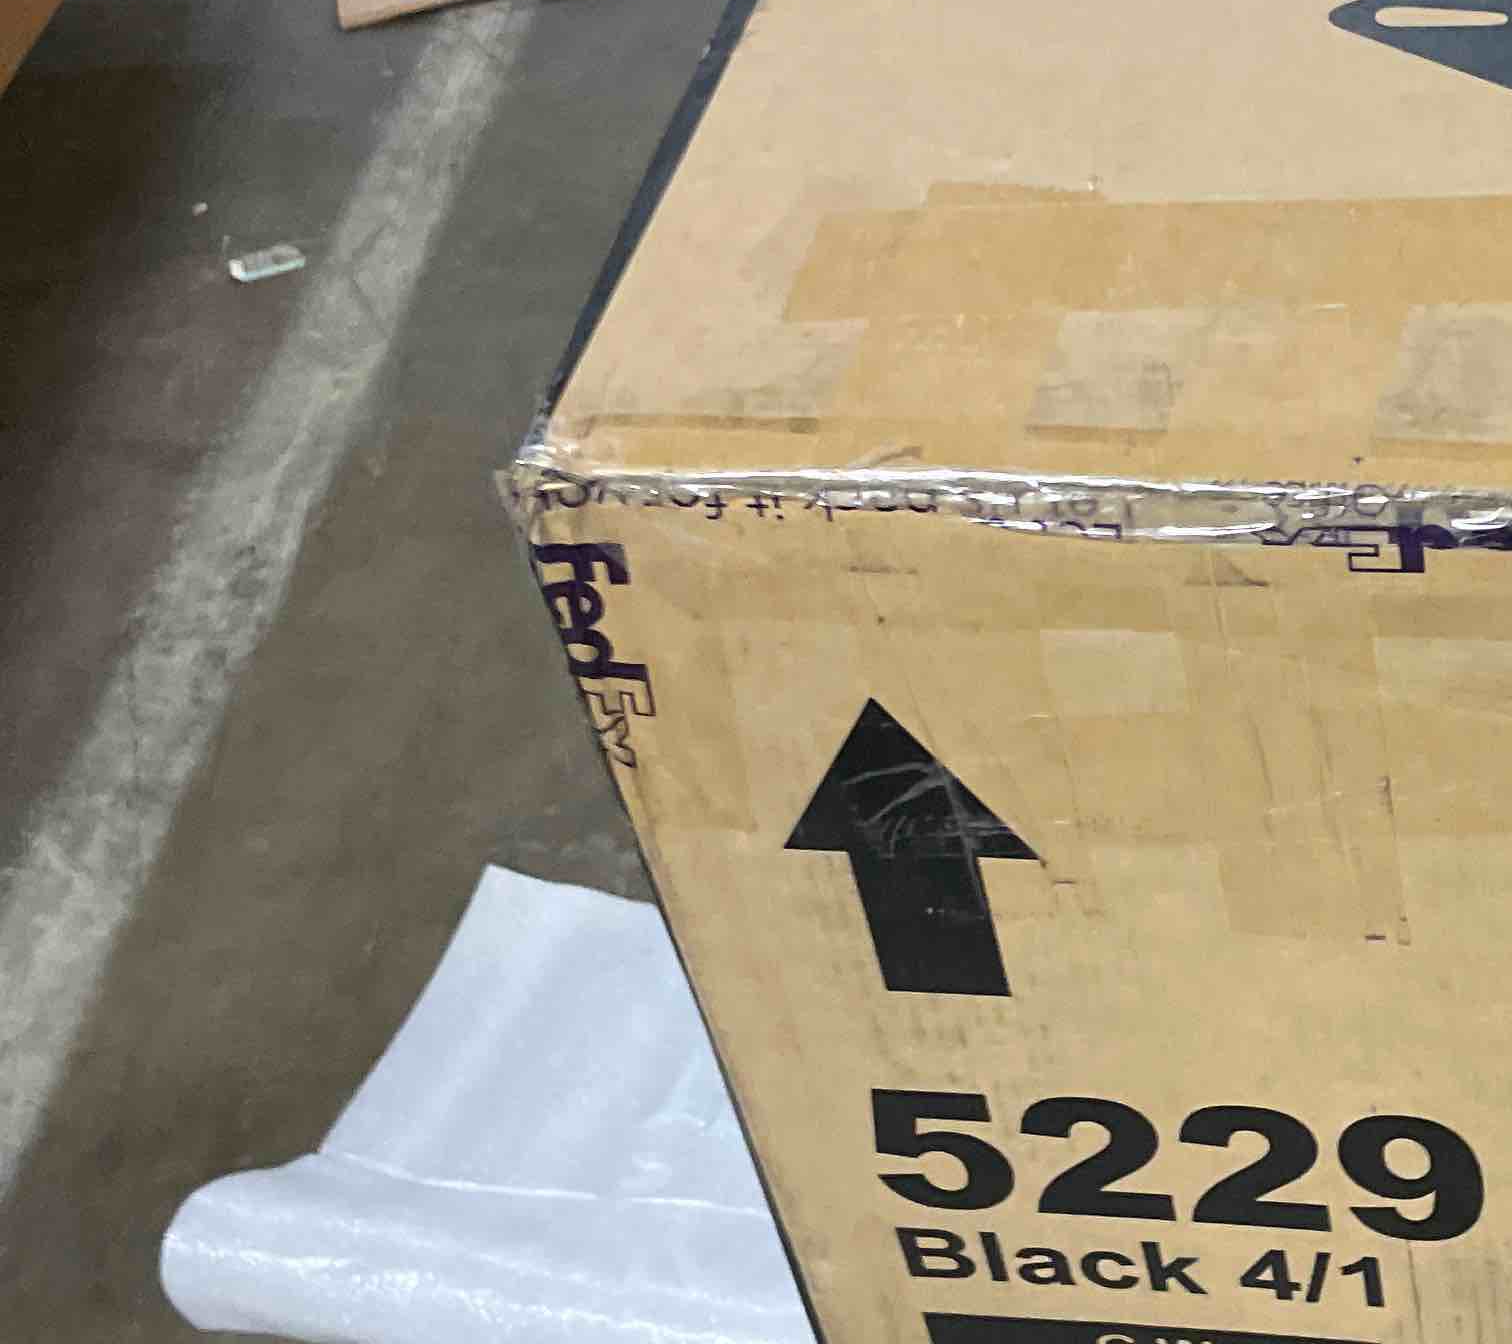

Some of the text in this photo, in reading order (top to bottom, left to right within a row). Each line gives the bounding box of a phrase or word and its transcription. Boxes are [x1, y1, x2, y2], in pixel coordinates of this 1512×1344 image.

[870, 1088, 1485, 1242] 5229
[894, 1226, 1386, 1308] Black 4/1
